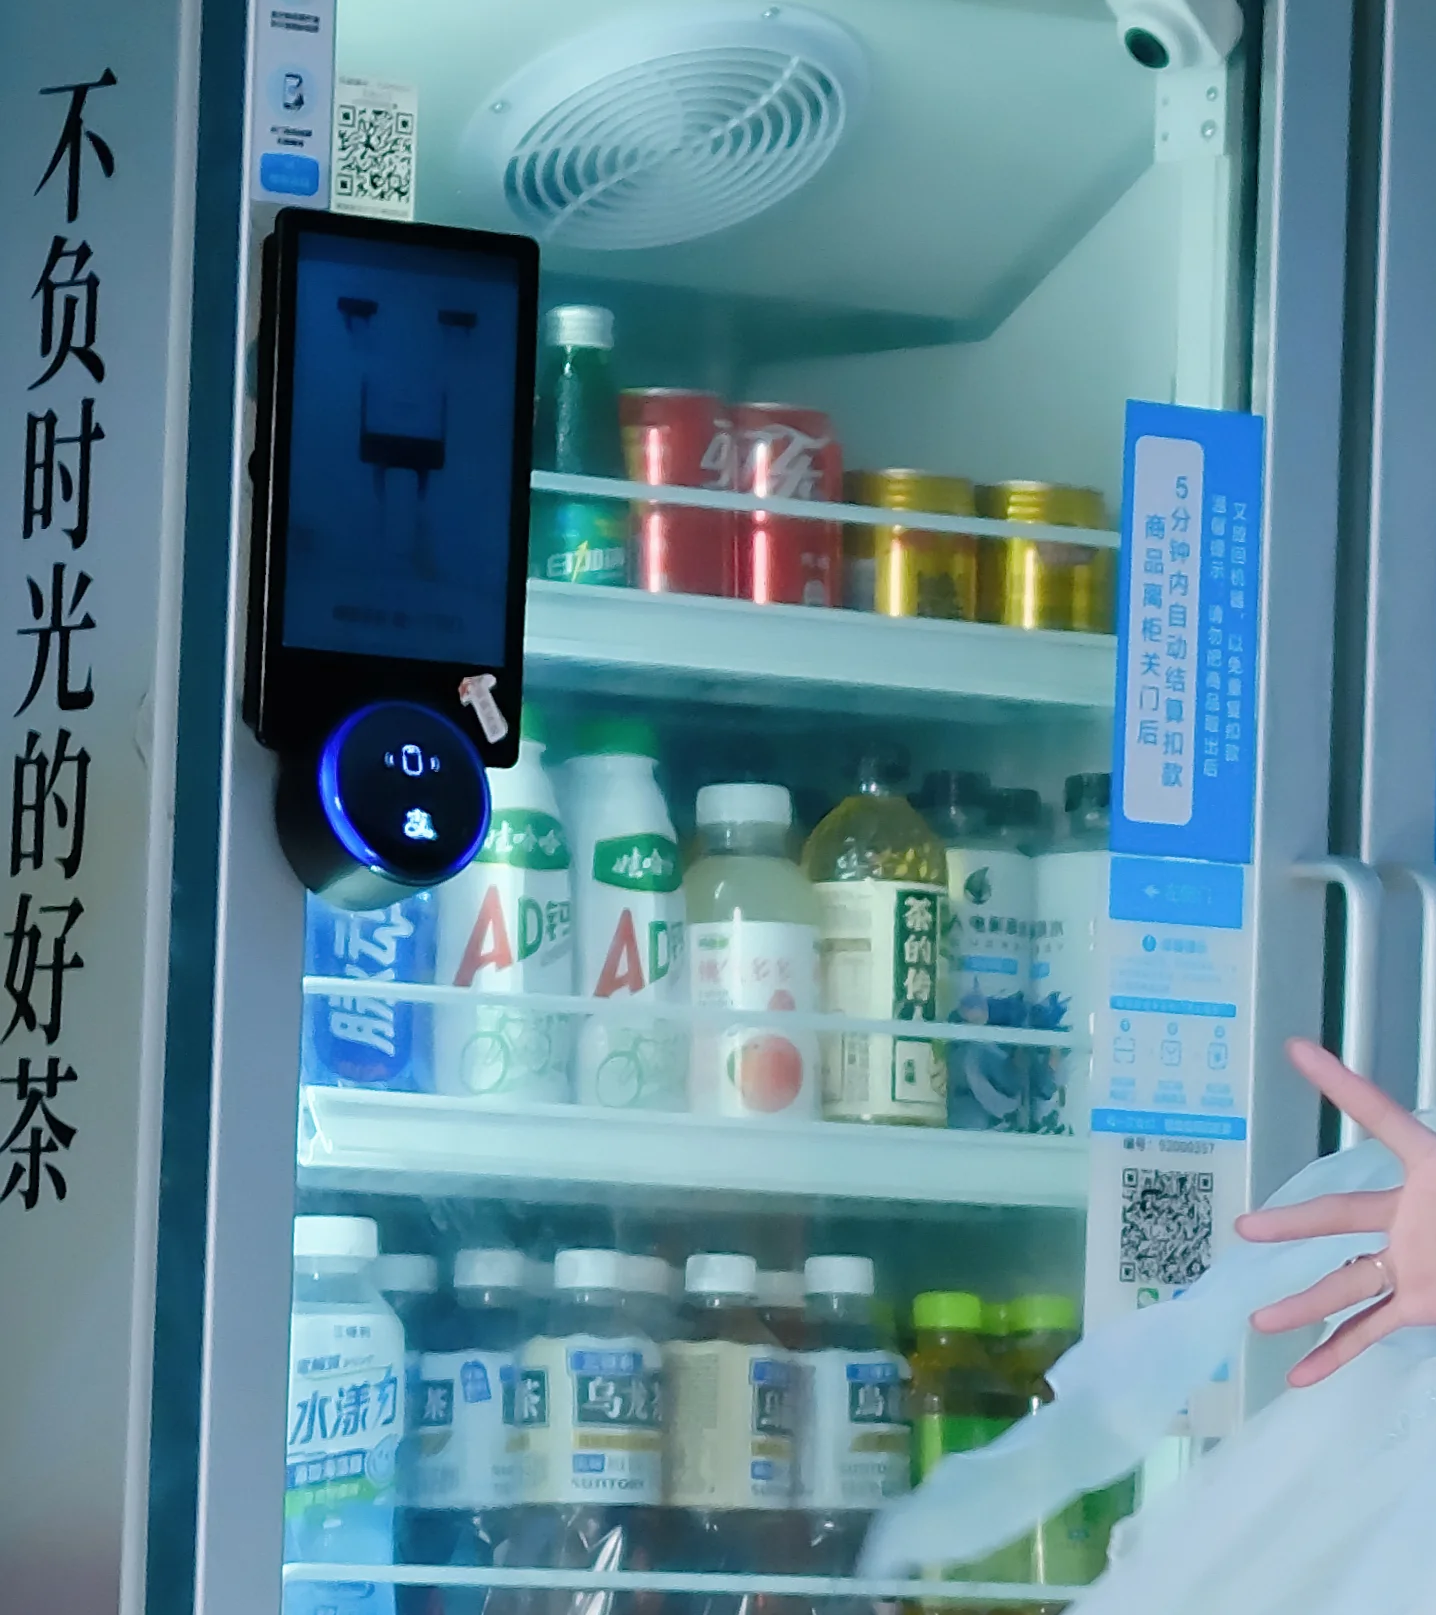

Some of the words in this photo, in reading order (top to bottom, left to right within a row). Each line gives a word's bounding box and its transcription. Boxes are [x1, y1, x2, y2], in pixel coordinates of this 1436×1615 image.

[0, 67, 118, 1210] 不负时光的好茶
